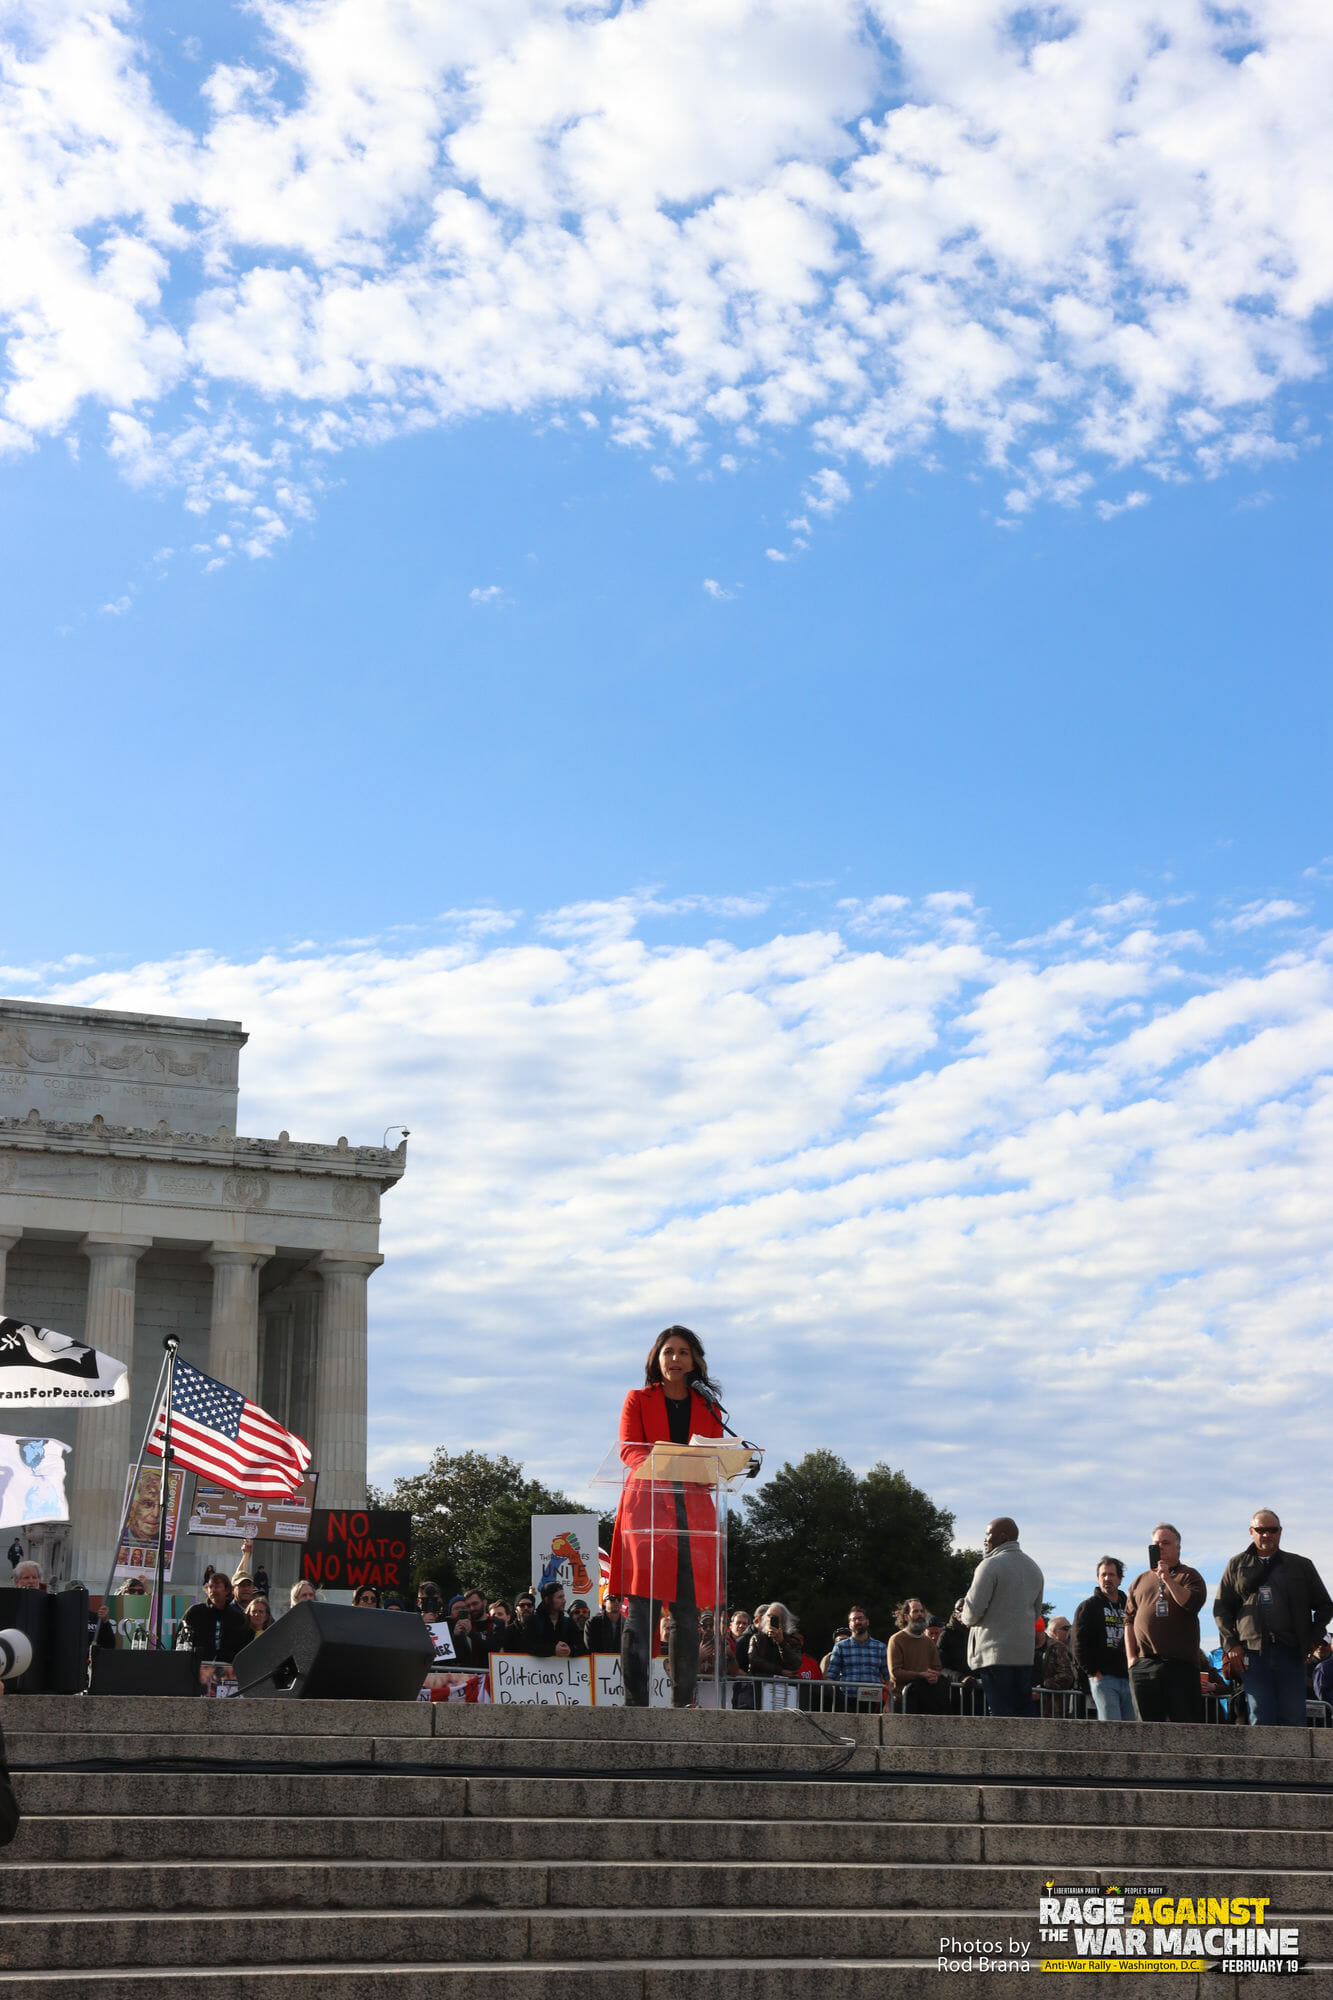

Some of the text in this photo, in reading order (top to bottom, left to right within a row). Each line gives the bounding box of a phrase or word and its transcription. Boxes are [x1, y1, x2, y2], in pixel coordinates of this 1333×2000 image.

[327, 1511, 369, 1542] NO
[346, 1538, 406, 1560] NATO
[303, 1551, 400, 1587] NO WAR
[542, 1563, 586, 1579] UNITE
[499, 1661, 564, 1686] Politicians
